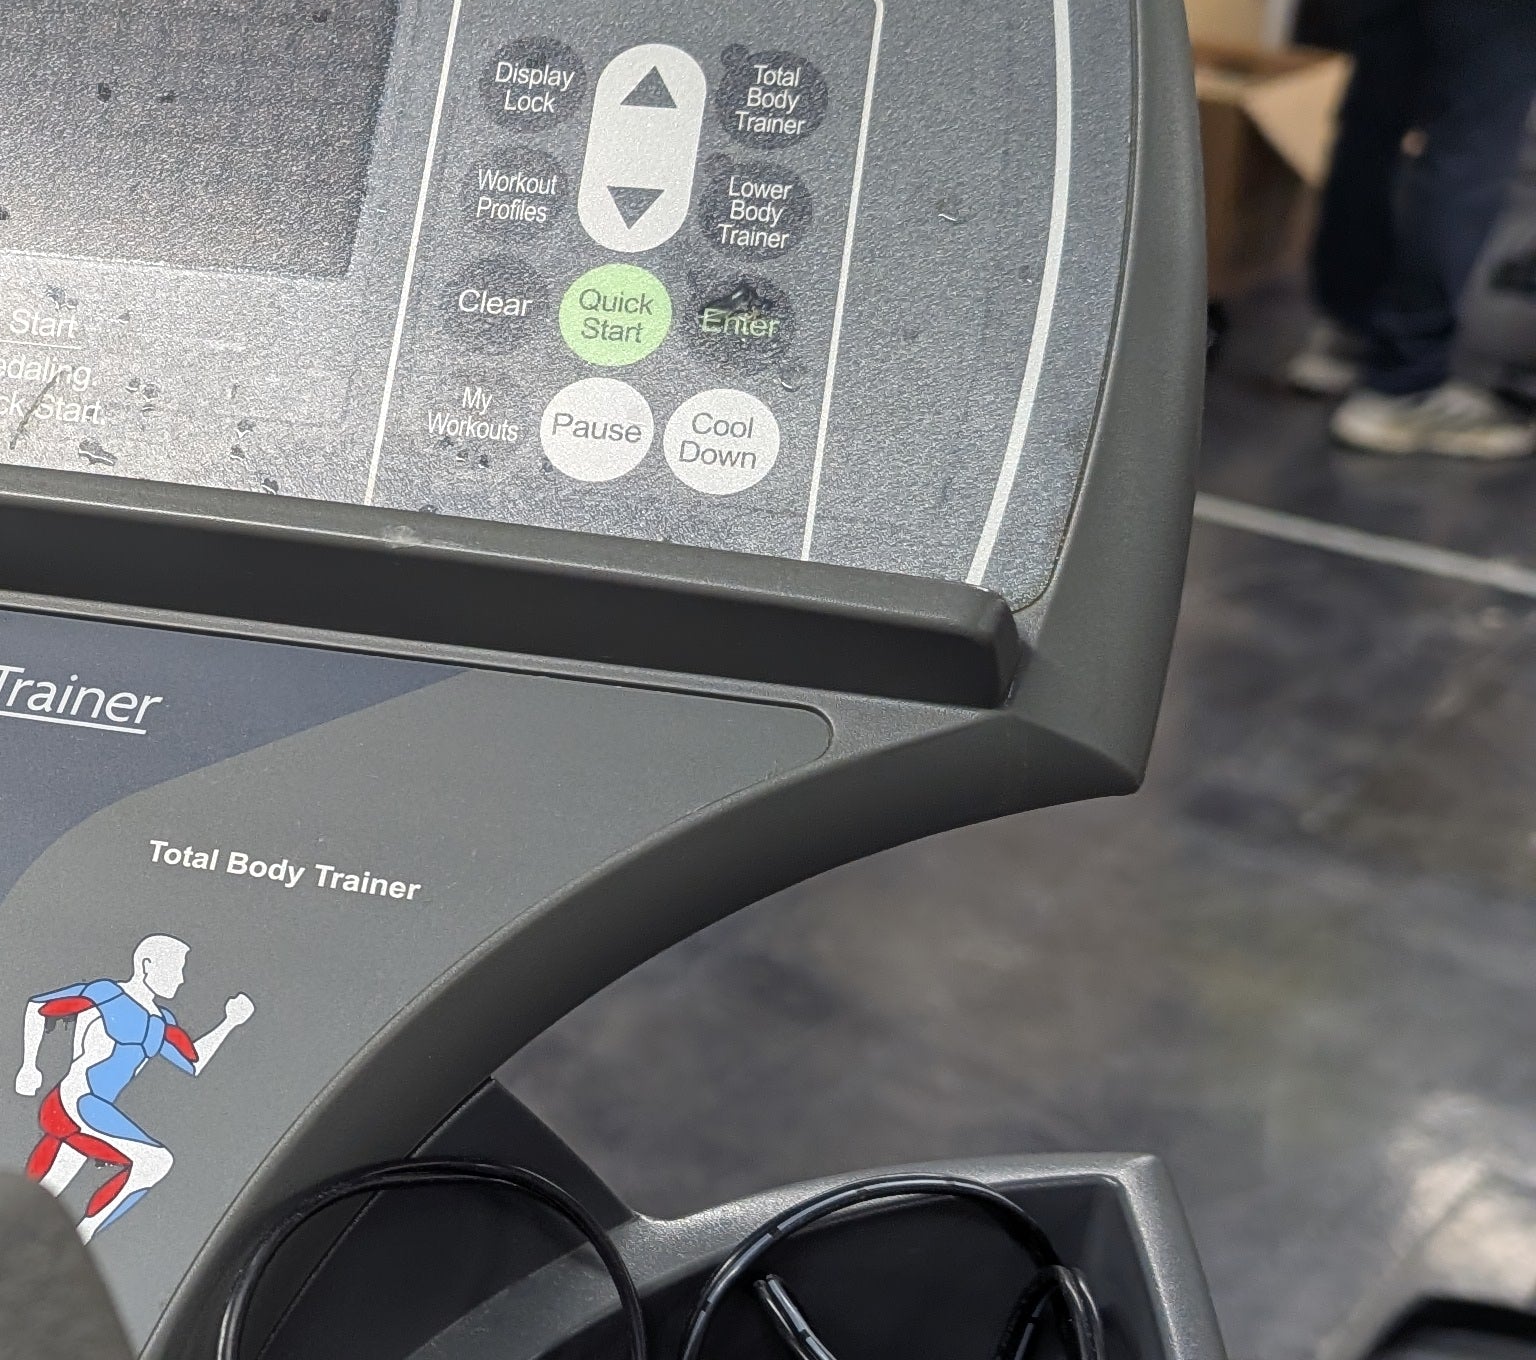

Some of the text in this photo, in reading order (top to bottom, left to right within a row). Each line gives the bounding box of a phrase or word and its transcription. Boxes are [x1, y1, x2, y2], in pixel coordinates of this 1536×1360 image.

[494, 61, 575, 91] Display
[752, 64, 801, 89] Total
[503, 89, 557, 113] Lock
[746, 86, 801, 114] Body
[734, 110, 807, 136] Trainer
[476, 167, 558, 196] Workout
[728, 175, 792, 201] Lower
[475, 196, 548, 224] Profiles
[728, 199, 785, 225] Body
[717, 223, 790, 249] Trainer
[457, 289, 533, 317] Clear
[577, 288, 654, 317] Quick
[9, 307, 78, 339] Start
[580, 316, 644, 344] Start
[700, 308, 781, 339] Enter
[33, 393, 106, 426] Start.
[461, 386, 493, 418] My
[426, 413, 519, 442] Workouts
[550, 413, 643, 444] Pause
[689, 411, 755, 439] Cool
[678, 440, 758, 470] Down
[149, 839, 422, 901] Total Body Trainer
